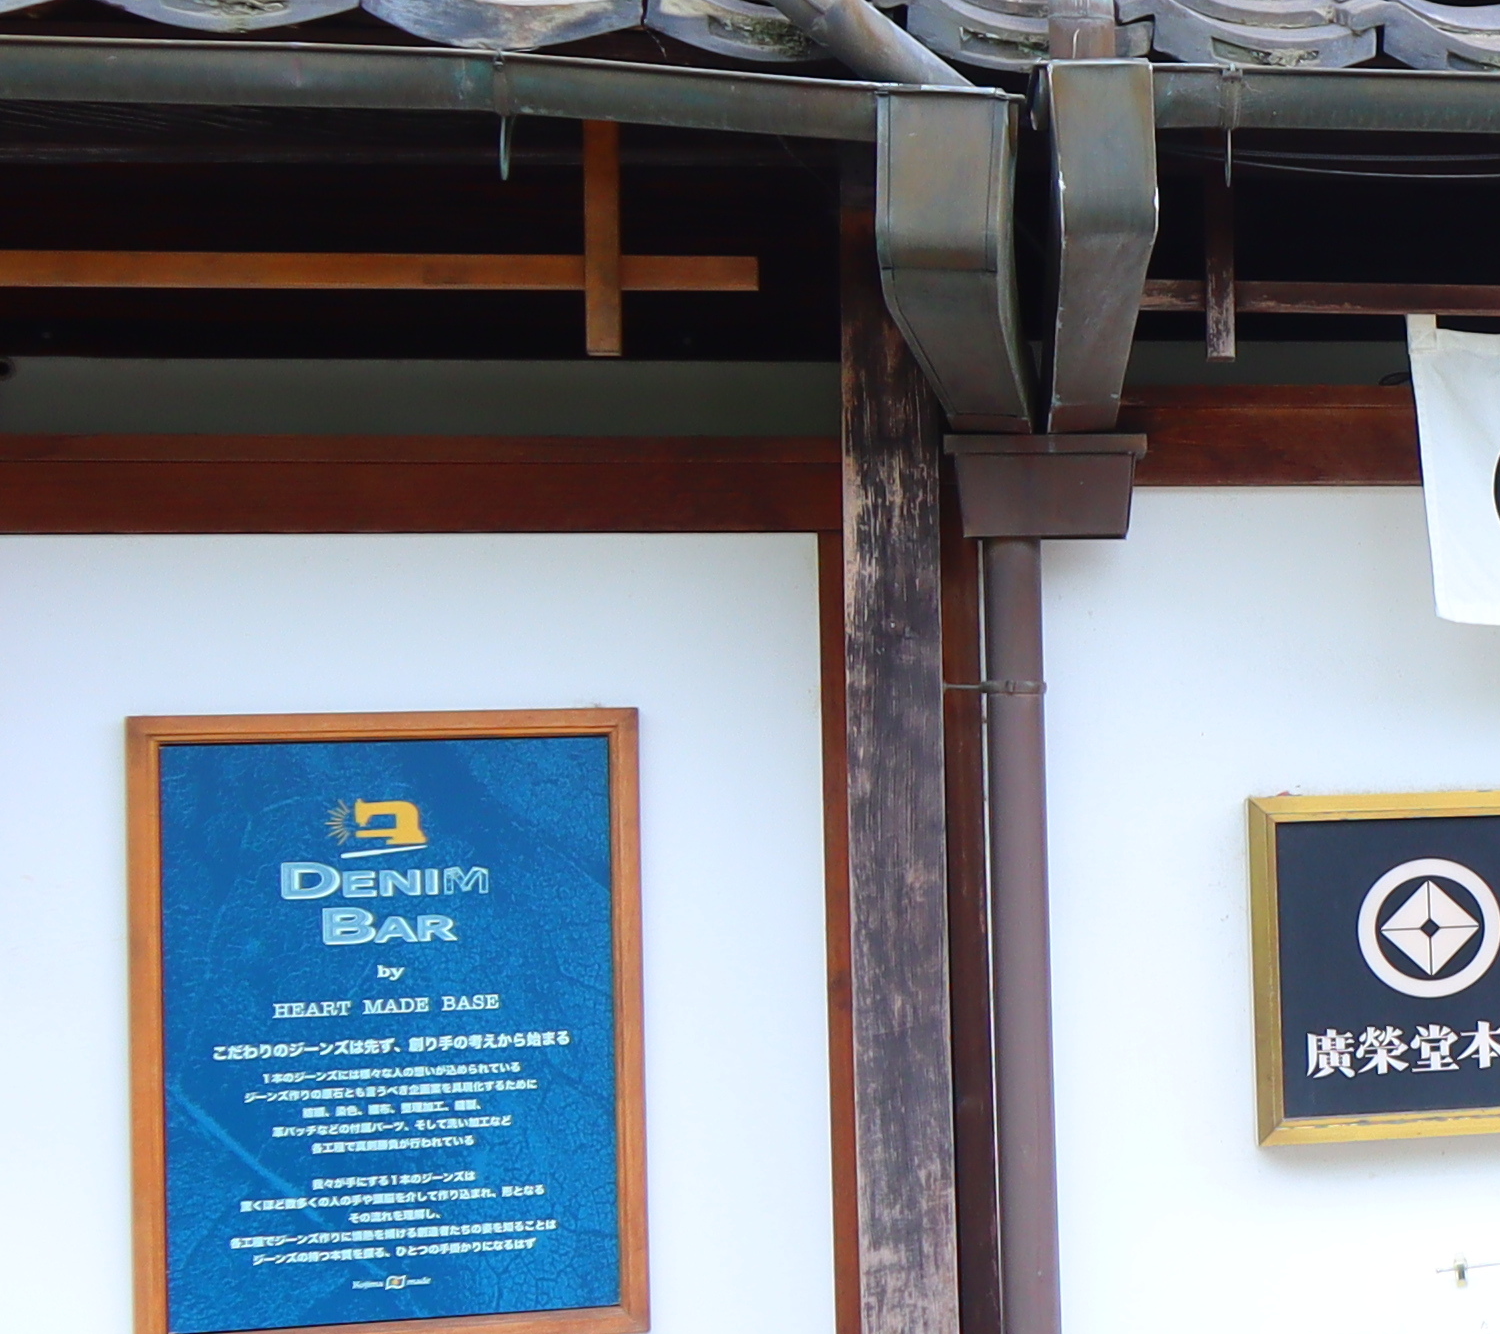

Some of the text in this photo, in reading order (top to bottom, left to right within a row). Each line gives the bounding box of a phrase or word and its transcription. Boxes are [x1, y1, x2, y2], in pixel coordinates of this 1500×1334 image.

[280, 861, 489, 900] DENIM
[321, 907, 457, 946] BAR
[376, 965, 405, 981] by
[272, 993, 500, 1020] HEART MADE BASE
